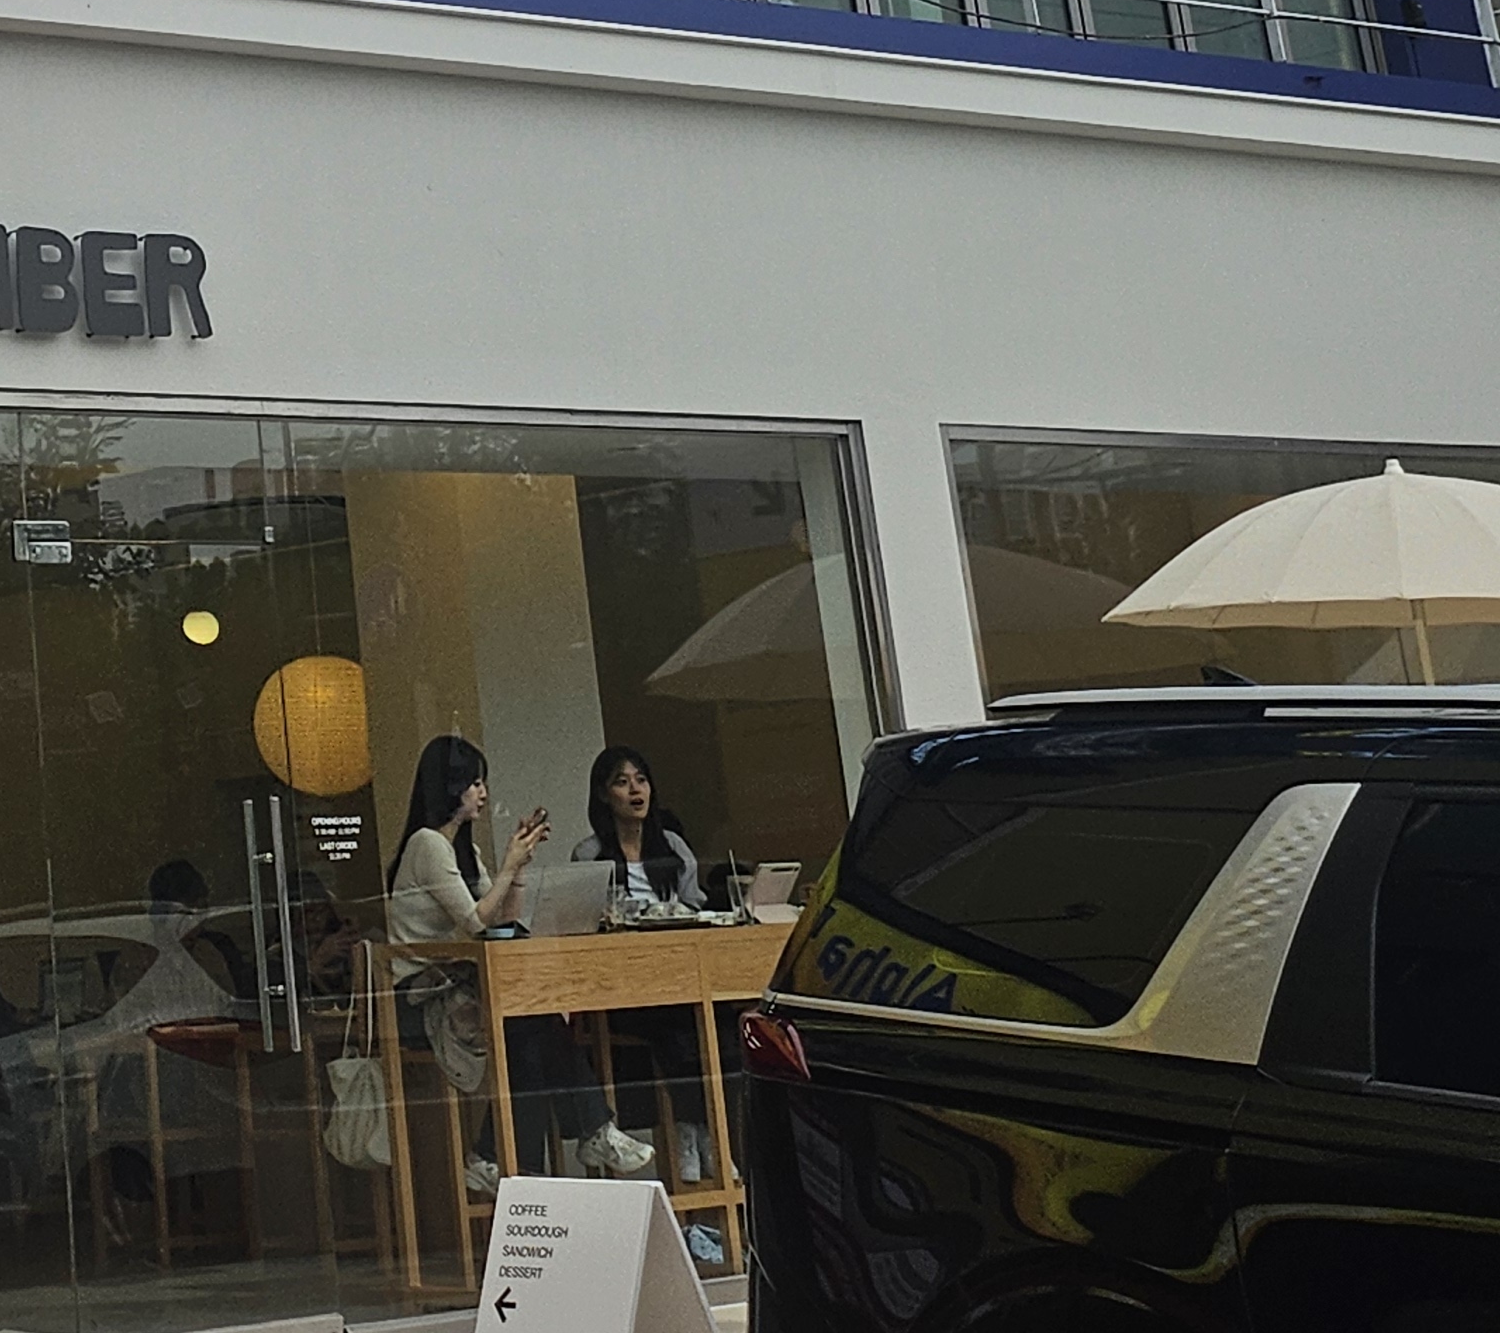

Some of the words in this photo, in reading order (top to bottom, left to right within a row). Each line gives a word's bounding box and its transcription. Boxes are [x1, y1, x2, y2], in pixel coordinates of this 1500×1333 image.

[509, 1203, 548, 1218] COFFEE
[505, 1223, 569, 1239] SOURDOUGH
[502, 1244, 554, 1259] SANDWICH
[499, 1265, 543, 1280] DESSERT
